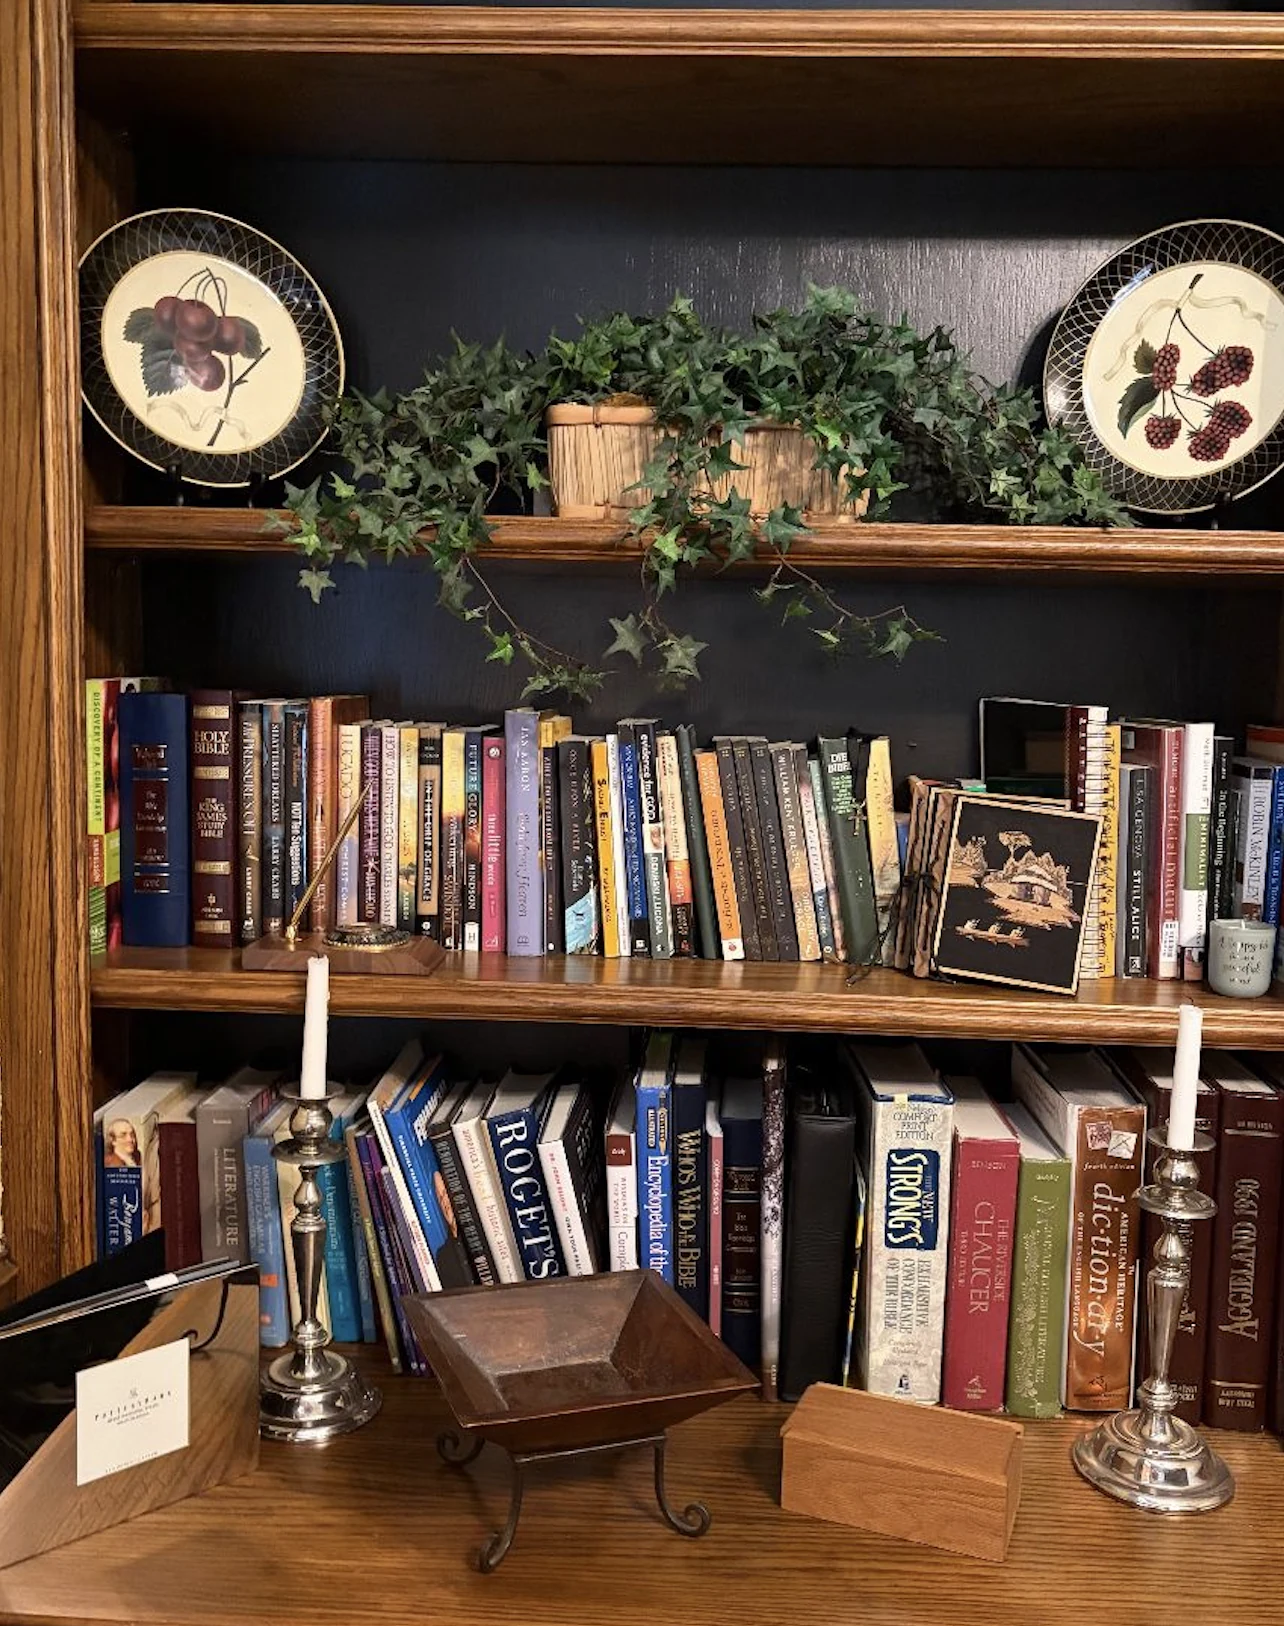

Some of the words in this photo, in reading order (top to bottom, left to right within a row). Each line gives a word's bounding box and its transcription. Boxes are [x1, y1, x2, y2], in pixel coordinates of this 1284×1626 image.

[93, 692, 101, 743] DISCOVERY
[93, 747, 101, 758] OF
[193, 743, 230, 755] BIBLE
[194, 731, 230, 742] HOLY
[270, 723, 281, 780] SHATTERED
[384, 735, 395, 758] HOW
[340, 734, 353, 799] LUCADO
[385, 761, 395, 774] TO
[468, 744, 477, 790] FUTURE
[569, 749, 578, 777] ONCE
[640, 734, 653, 778] evidence
[424, 780, 432, 793] IN
[641, 779, 652, 795] for
[778, 755, 791, 795] WILLIAM
[94, 771, 102, 822] CONTINENT
[199, 803, 224, 812] KING
[271, 783, 281, 822] DREAMS
[384, 777, 395, 810] LISTEN
[424, 795, 432, 817] THE
[569, 781, 579, 807] UPON
[645, 796, 657, 821] GOD
[783, 797, 794, 822] KENT
[1218, 801, 1228, 818] the
[1220, 790, 1229, 801] In
[196, 812, 227, 822] JAMES
[197, 822, 224, 830] STUDY
[291, 802, 302, 820] NOT
[384, 812, 394, 825] TO
[468, 793, 477, 831] GLORY
[487, 813, 496, 834] three
[1168, 785, 1179, 856] artificial
[1251, 797, 1265, 836] ROBIN
[201, 830, 223, 838] BIBLE
[384, 826, 395, 848] GOD
[424, 821, 432, 847] GRIP
[487, 835, 500, 862] little
[571, 823, 580, 851] RIVER
[786, 824, 801, 870] KRUEGER
[1134, 809, 1144, 858] GENOVA
[1214, 818, 1227, 866] Beginning
[271, 836, 281, 865] LARRY
[289, 836, 302, 886] Suggestions
[424, 850, 432, 865] OF
[1197, 823, 1207, 887] MINIMALIST
[383, 852, 393, 887] CHARLES
[423, 867, 432, 901] GRACE
[468, 863, 477, 909] HINDSON
[1132, 869, 1142, 902] STILL
[794, 900, 805, 932] GRACE
[803, 891, 816, 942] ORDINARY
[1131, 905, 1140, 941] ALICE
[893, 1112, 938, 1122] COMFORT
[901, 1121, 929, 1131] PRINT
[462, 1129, 483, 1169] america's
[896, 1130, 934, 1141] EDITION
[436, 1140, 461, 1193] RENOVATION
[1083, 1162, 1108, 1171] fourth
[224, 1148, 239, 1246] LITERATURE
[452, 1195, 464, 1206] OF
[495, 1117, 559, 1279] ROGET'S
[552, 1166, 562, 1185] JOHN
[568, 1235, 578, 1253] YOUR
[643, 1156, 669, 1240] Encyclopedia
[679, 1185, 701, 1230] WHO
[886, 1153, 929, 1247] STRONG'S
[921, 1190, 935, 1223] NEW
[1233, 1178, 1260, 1218] 1990
[109, 1196, 119, 1246] WALTER
[458, 1207, 473, 1225] THE
[997, 1219, 1009, 1241] THE
[1077, 1212, 1085, 1222] OF
[464, 1225, 484, 1251] HEART
[650, 1242, 670, 1255] of
[1118, 1212, 1130, 1270] AMERICAN
[678, 1247, 701, 1288] BIBLE
[886, 1258, 900, 1271] OF
[968, 1201, 996, 1313] CHAUCER
[994, 1243, 1007, 1301] RIVERSIDE
[1075, 1245, 1083, 1282] ENGLISH
[885, 1274, 899, 1297] THE
[899, 1258, 916, 1334] CONCORDANCE
[916, 1259, 932, 1327] EXHAUSTIVE
[1218, 1222, 1260, 1342] AGGIELAND
[884, 1300, 898, 1330] BIBLE
[1072, 1285, 1081, 1327] LANGUAGE
